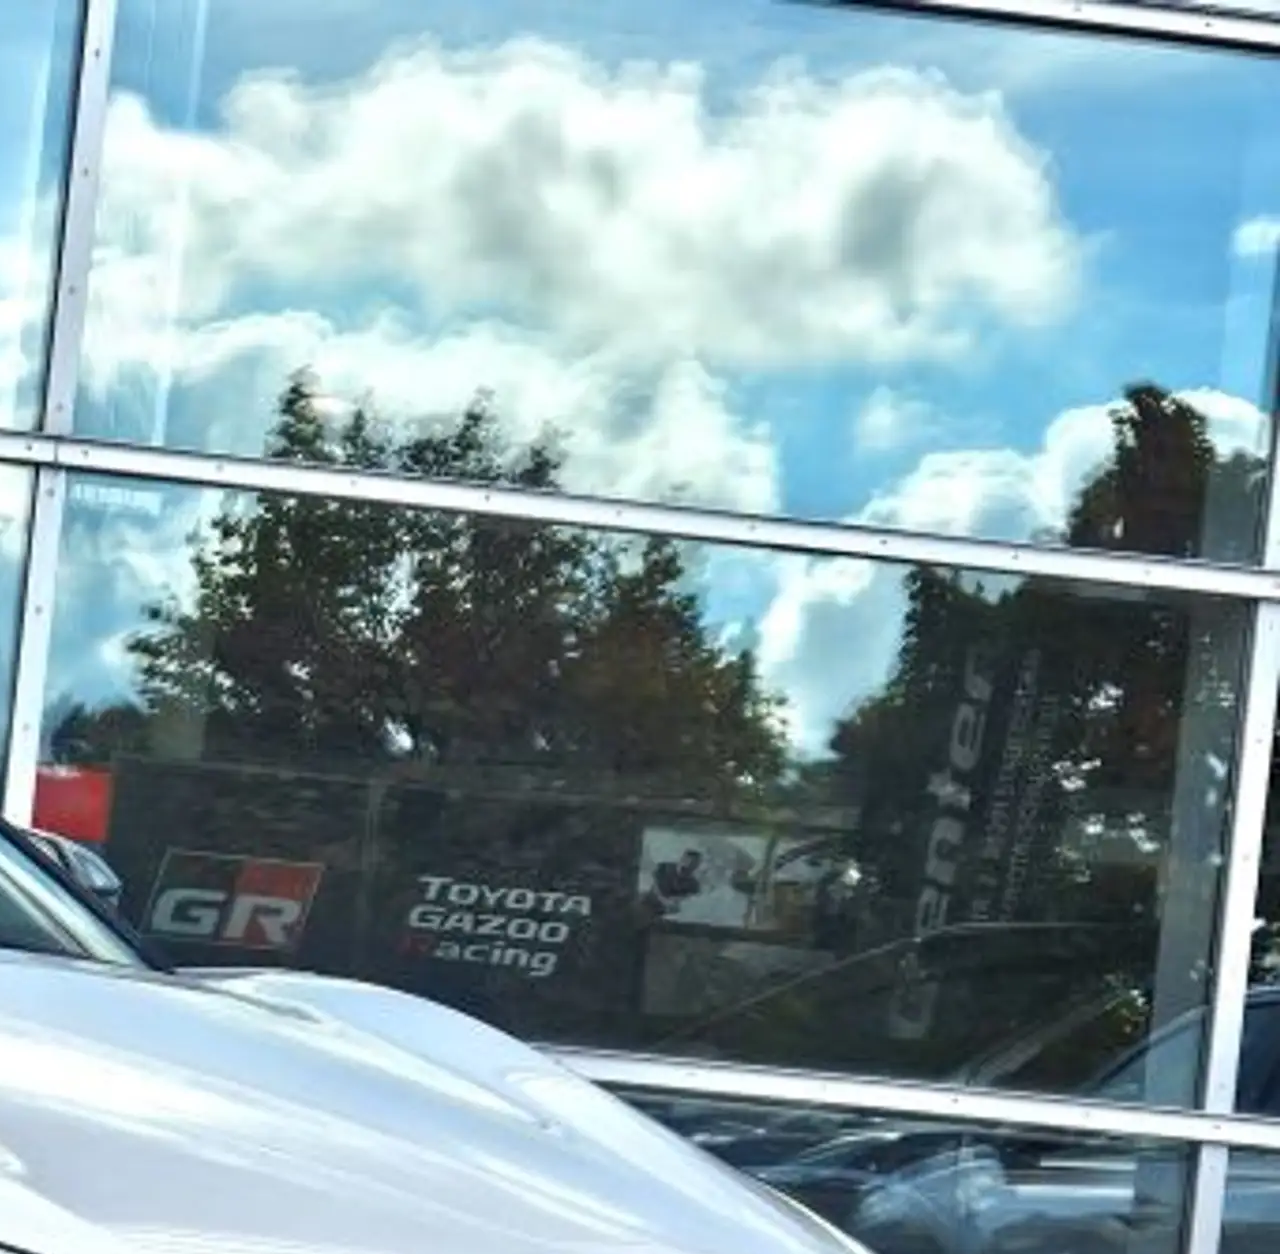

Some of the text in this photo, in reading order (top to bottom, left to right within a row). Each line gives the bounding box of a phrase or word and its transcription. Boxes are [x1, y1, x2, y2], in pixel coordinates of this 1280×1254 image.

[151, 887, 300, 943] GR
[417, 876, 592, 916] TOYOTA
[408, 905, 570, 943] GAZOO
